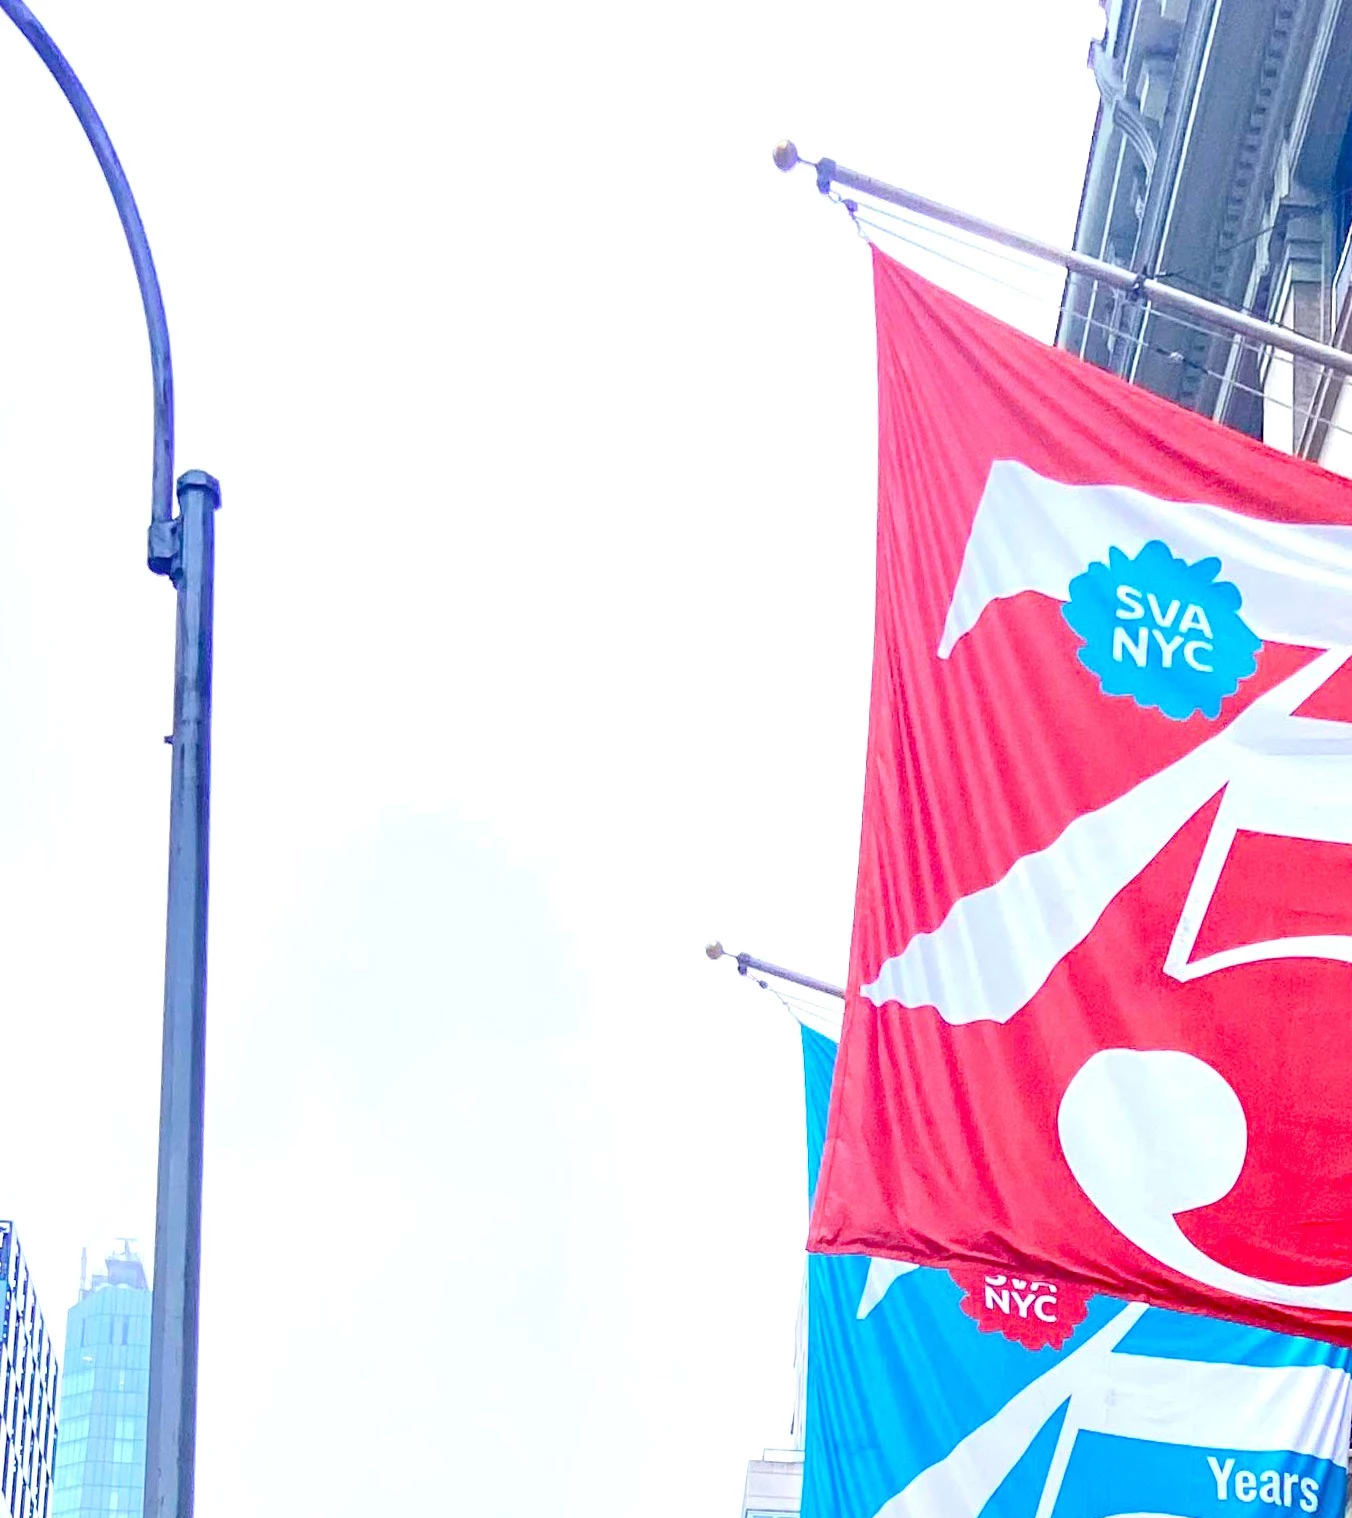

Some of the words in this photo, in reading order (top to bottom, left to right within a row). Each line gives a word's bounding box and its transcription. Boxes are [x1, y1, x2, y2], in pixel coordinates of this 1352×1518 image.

[1115, 584, 1214, 640] SVA
[1112, 626, 1214, 673] NYC
[984, 1284, 1058, 1323] NYC
[1206, 1455, 1319, 1513] Years
